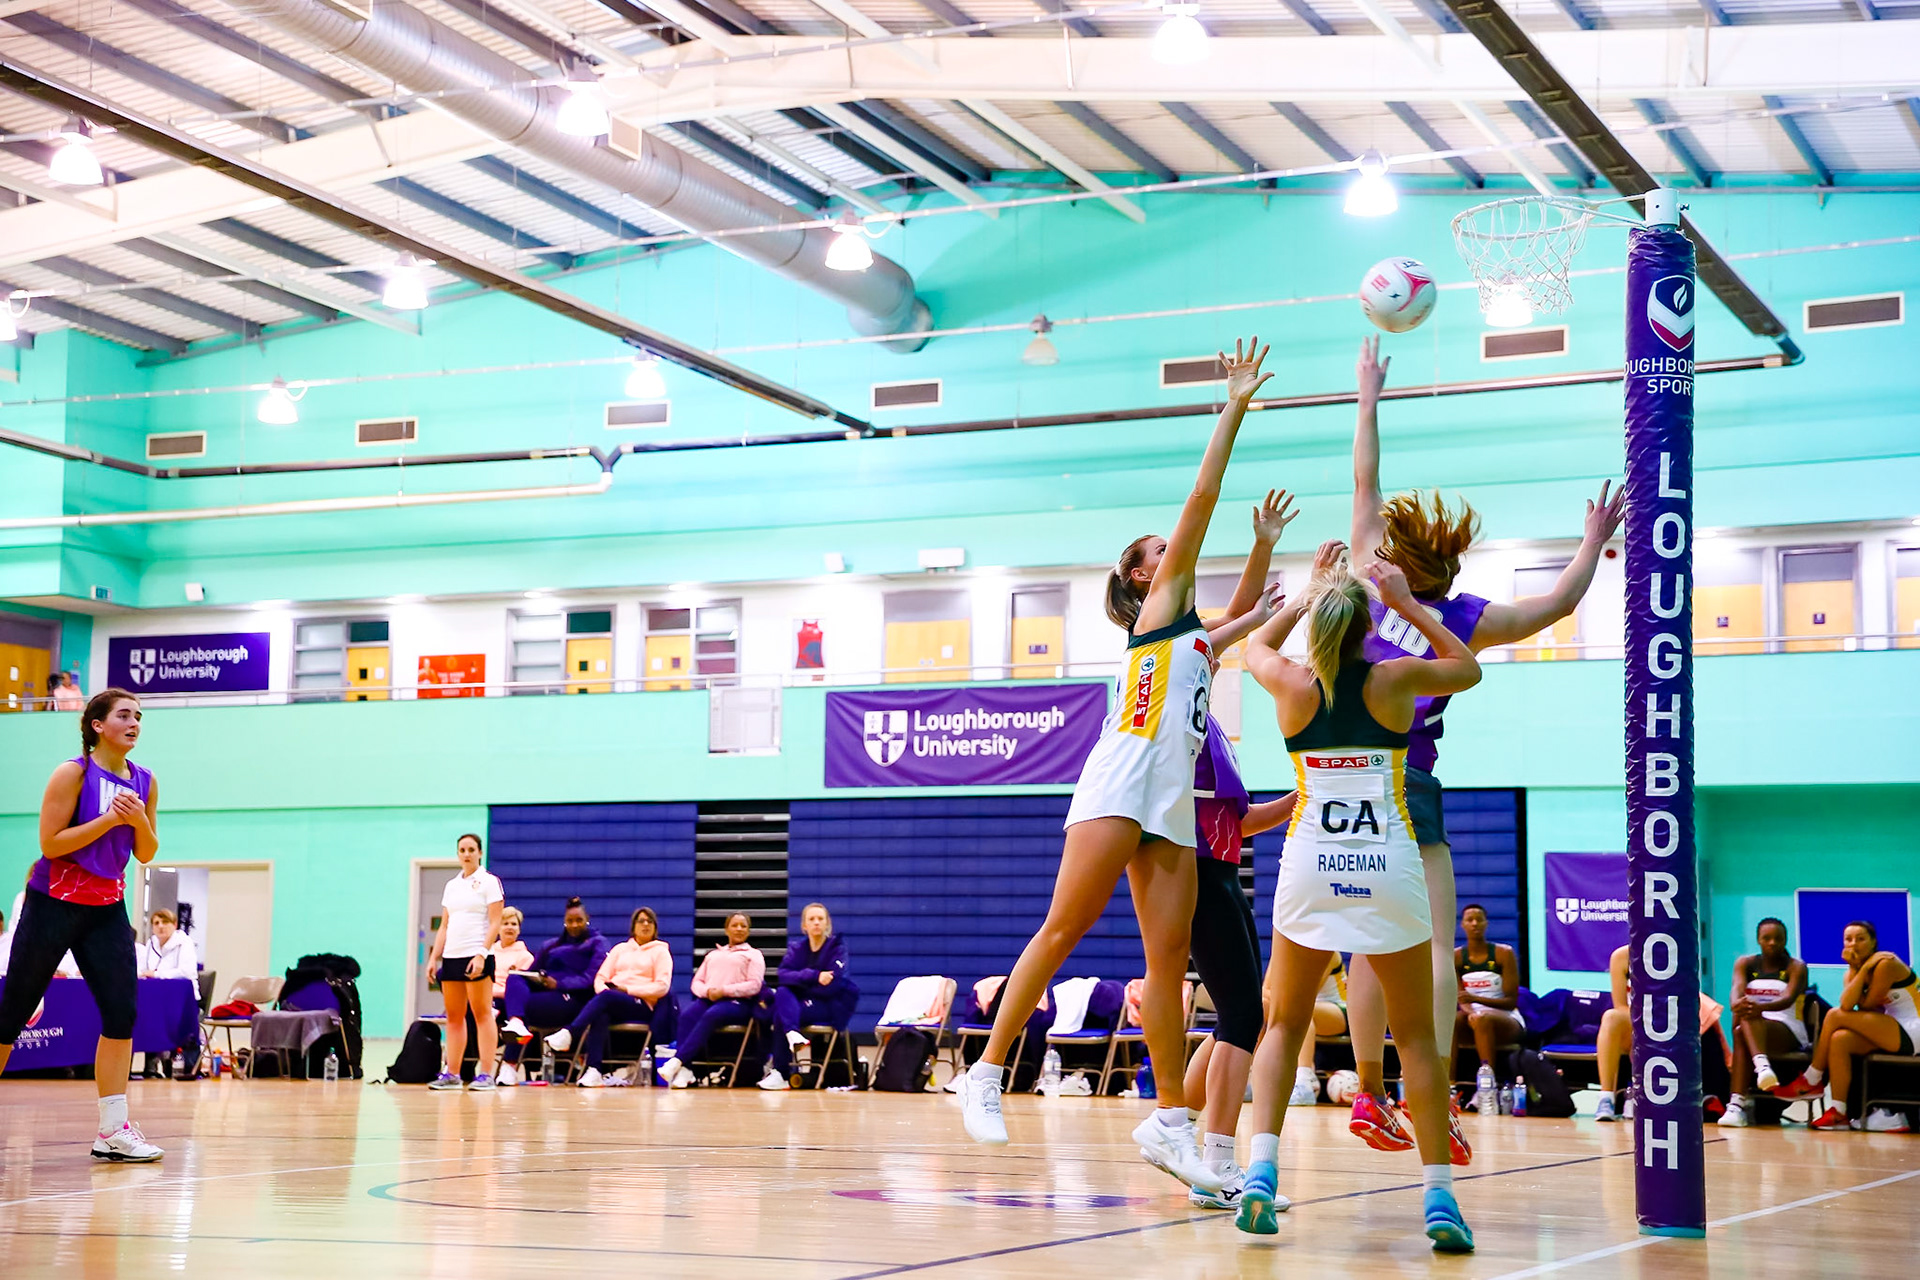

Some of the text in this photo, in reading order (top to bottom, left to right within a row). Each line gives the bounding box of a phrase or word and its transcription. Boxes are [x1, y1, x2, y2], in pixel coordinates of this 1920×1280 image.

[159, 645, 249, 666] Loughborough
[158, 663, 221, 681] University
[914, 706, 1065, 735] Loughborough
[913, 734, 1018, 760] University
[1319, 757, 1368, 768] SPAR
[1321, 800, 1380, 835] CA
[1643, 452, 1687, 1170] LOUGHBOROUGH
[1318, 854, 1386, 872] RADEMAN
